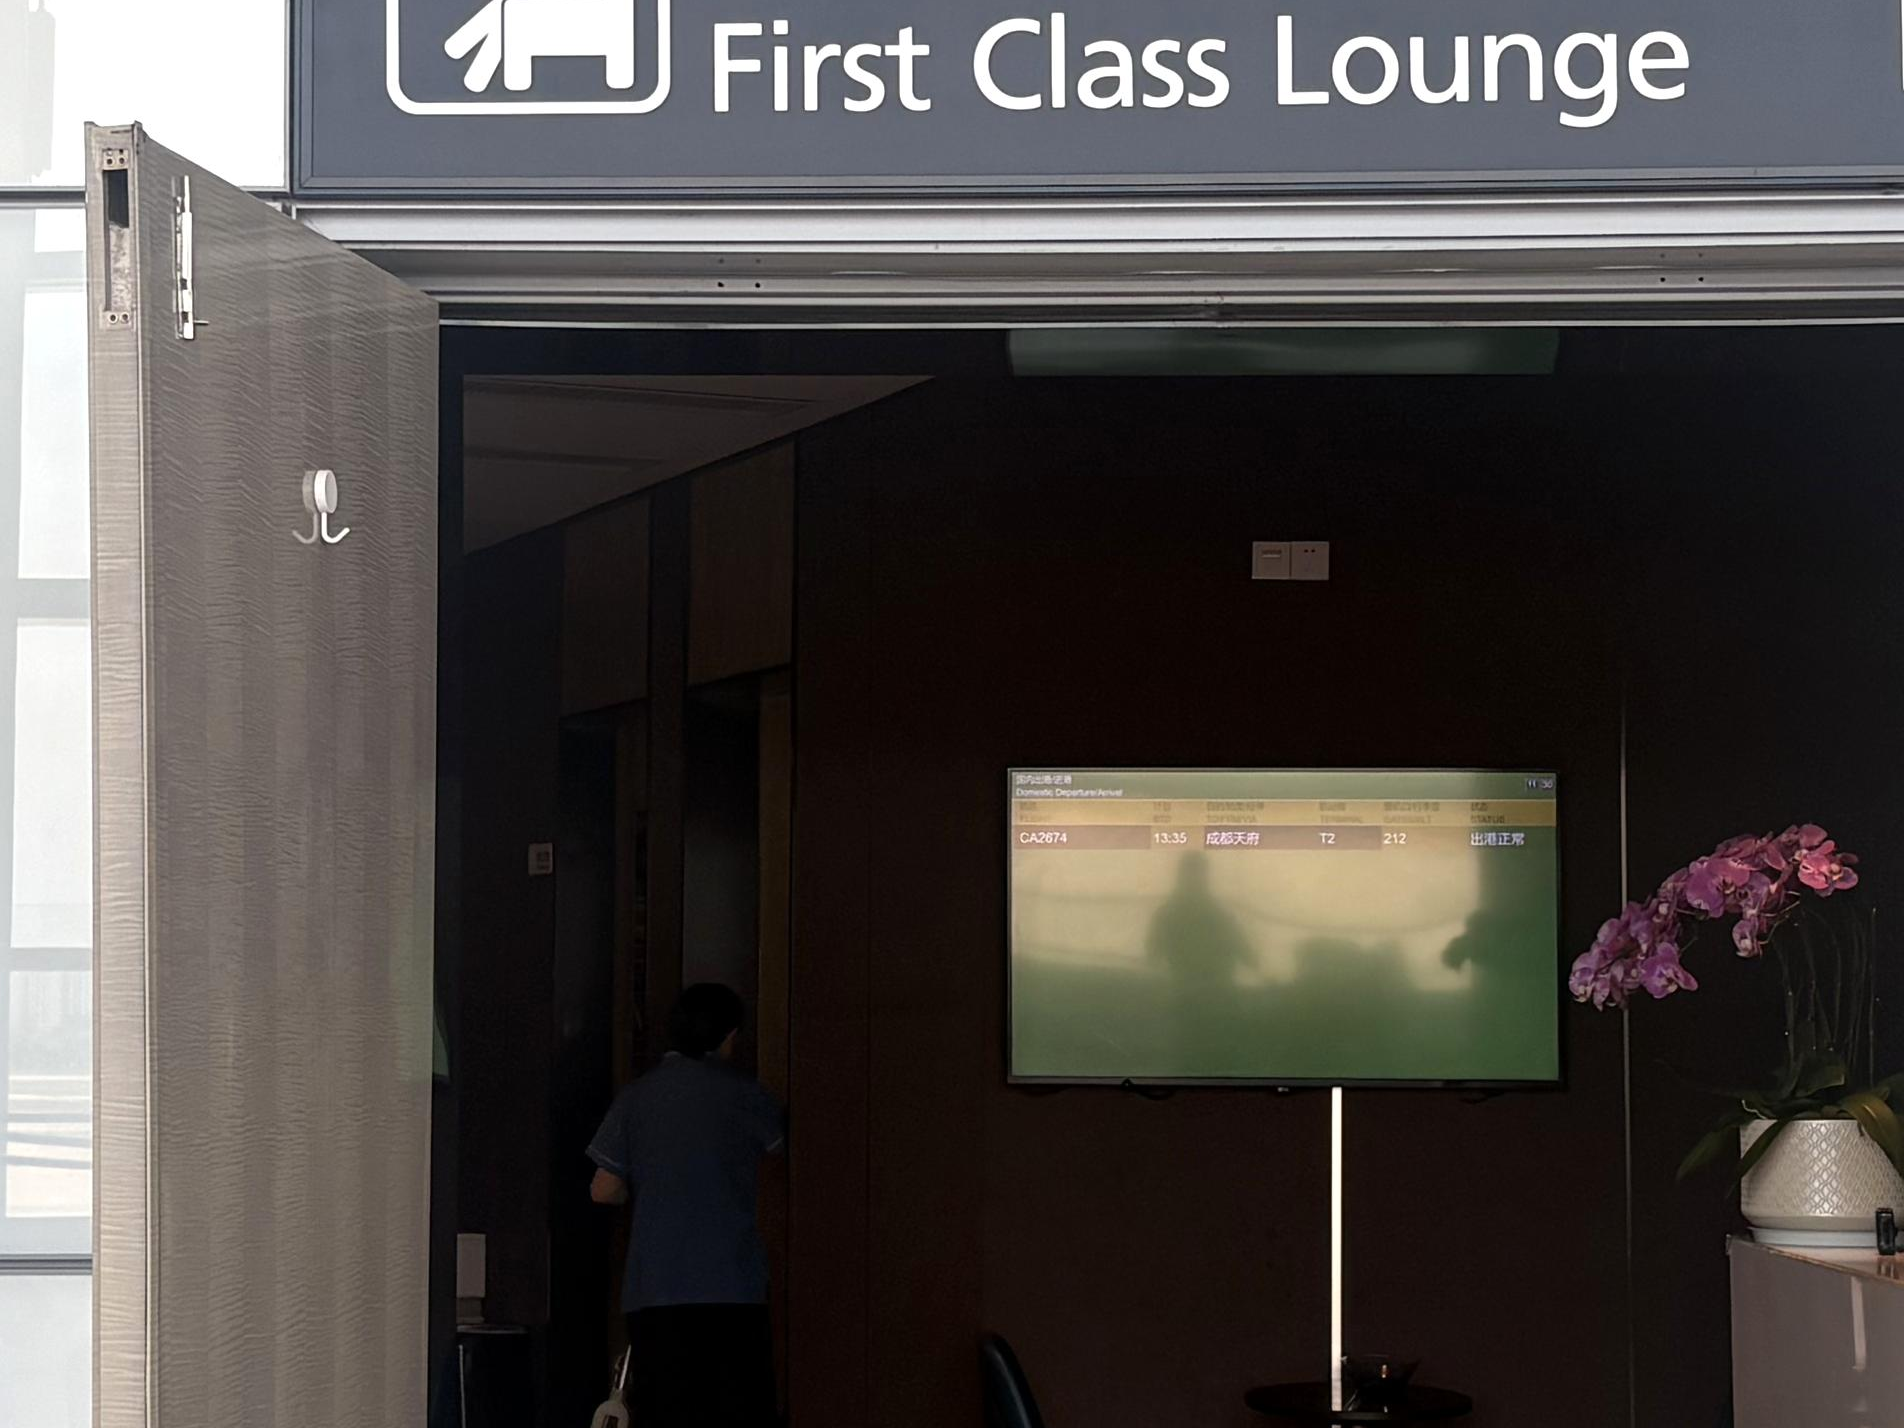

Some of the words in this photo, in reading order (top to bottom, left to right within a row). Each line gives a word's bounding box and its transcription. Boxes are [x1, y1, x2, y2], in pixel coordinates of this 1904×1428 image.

[715, 20, 930, 111] First
[974, 13, 1229, 109] Class
[1278, 16, 1689, 127] Lounge
[1019, 831, 1068, 844] CA2674
[1153, 831, 1187, 844] 13:35
[1319, 832, 1336, 844] T2
[1383, 832, 1407, 844] 212
